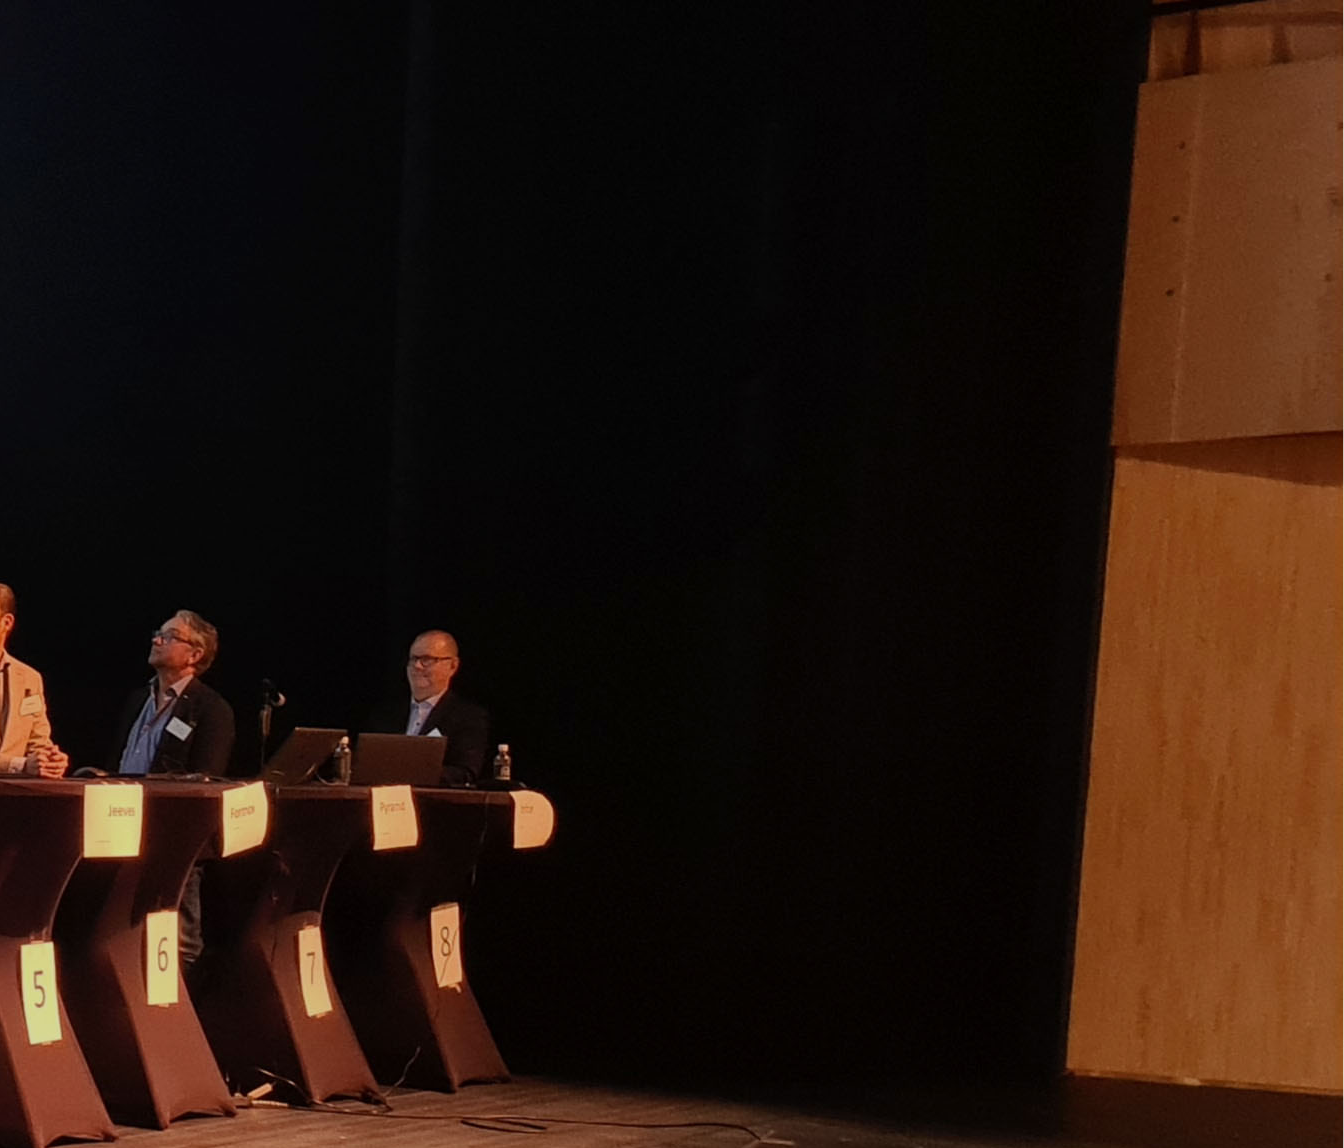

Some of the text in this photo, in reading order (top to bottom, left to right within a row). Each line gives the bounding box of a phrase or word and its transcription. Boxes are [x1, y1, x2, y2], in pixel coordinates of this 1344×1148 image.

[157, 936, 169, 972] 6
[440, 926, 451, 957] 8
[306, 951, 316, 985] 7
[33, 970, 46, 1009] 5
